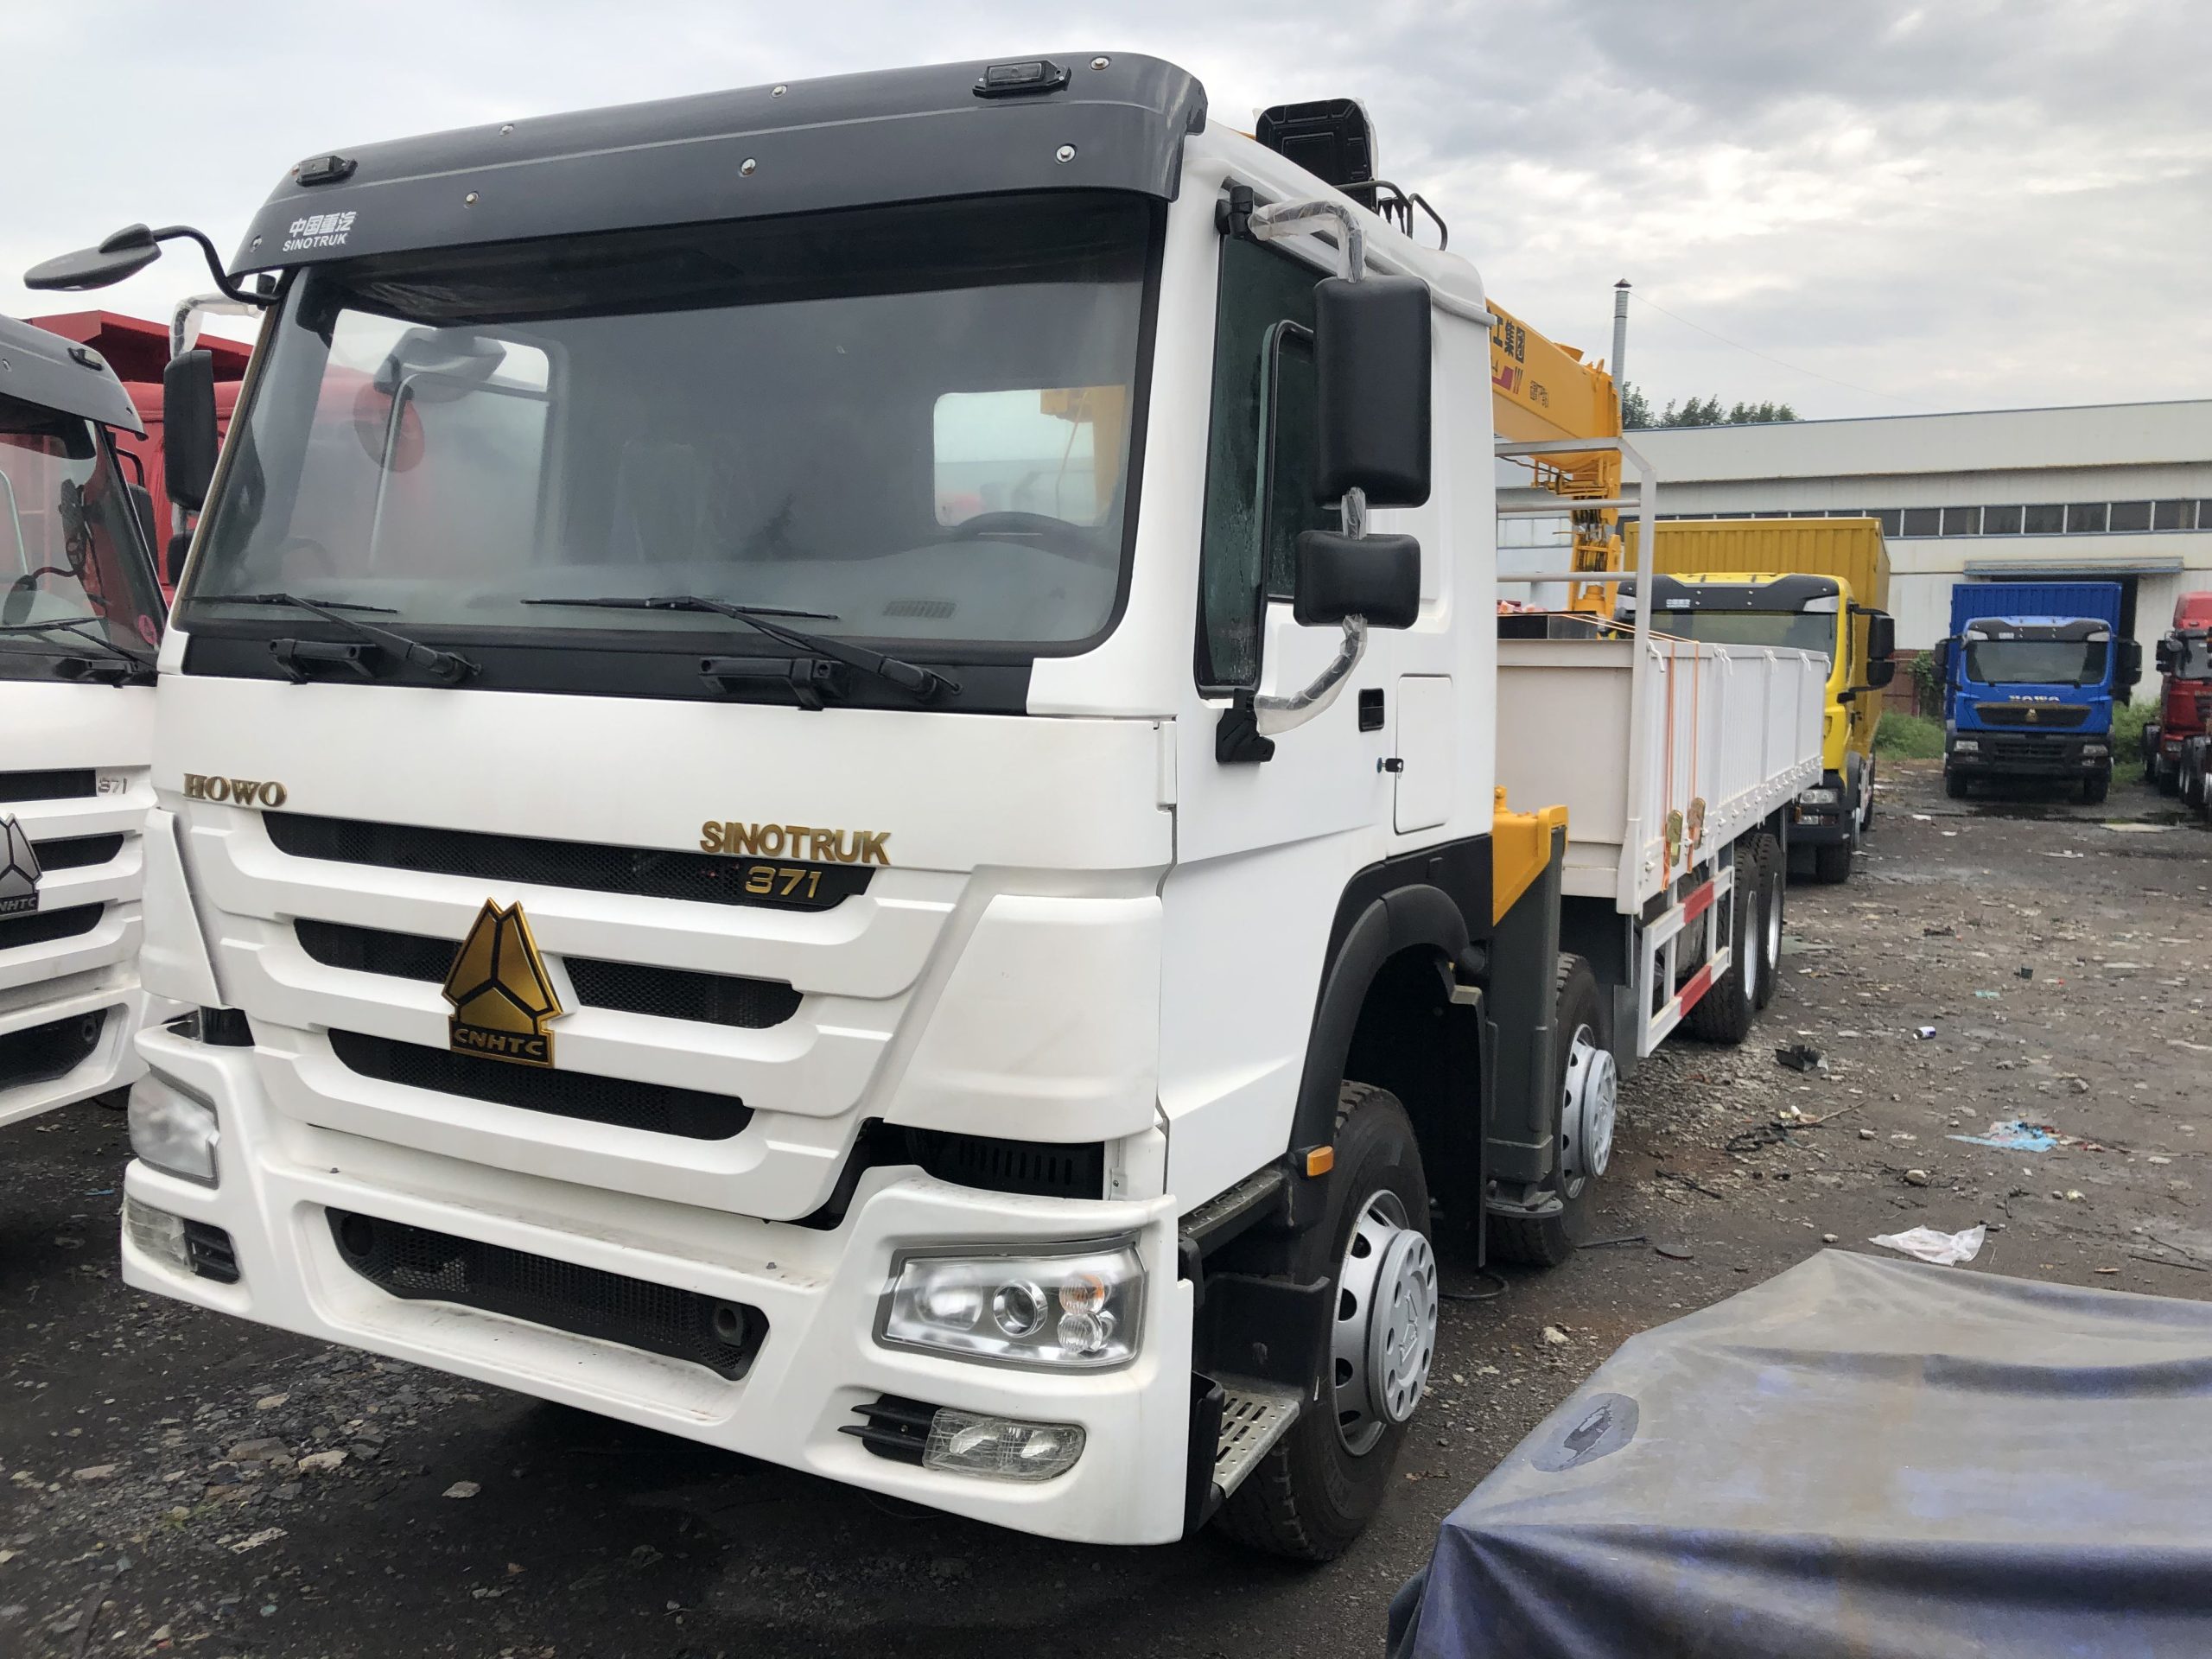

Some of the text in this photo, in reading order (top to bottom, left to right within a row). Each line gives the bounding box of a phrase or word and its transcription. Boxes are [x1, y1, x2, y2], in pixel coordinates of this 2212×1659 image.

[289, 211, 357, 238] 中国重汽
[282, 232, 348, 252] SINOTRUK
[182, 772, 288, 808] HOWO
[699, 820, 892, 866] SINOTRUK
[745, 866, 823, 899] 371
[0, 896, 37, 912] NHTC
[454, 1027, 544, 1056] CNHTC
